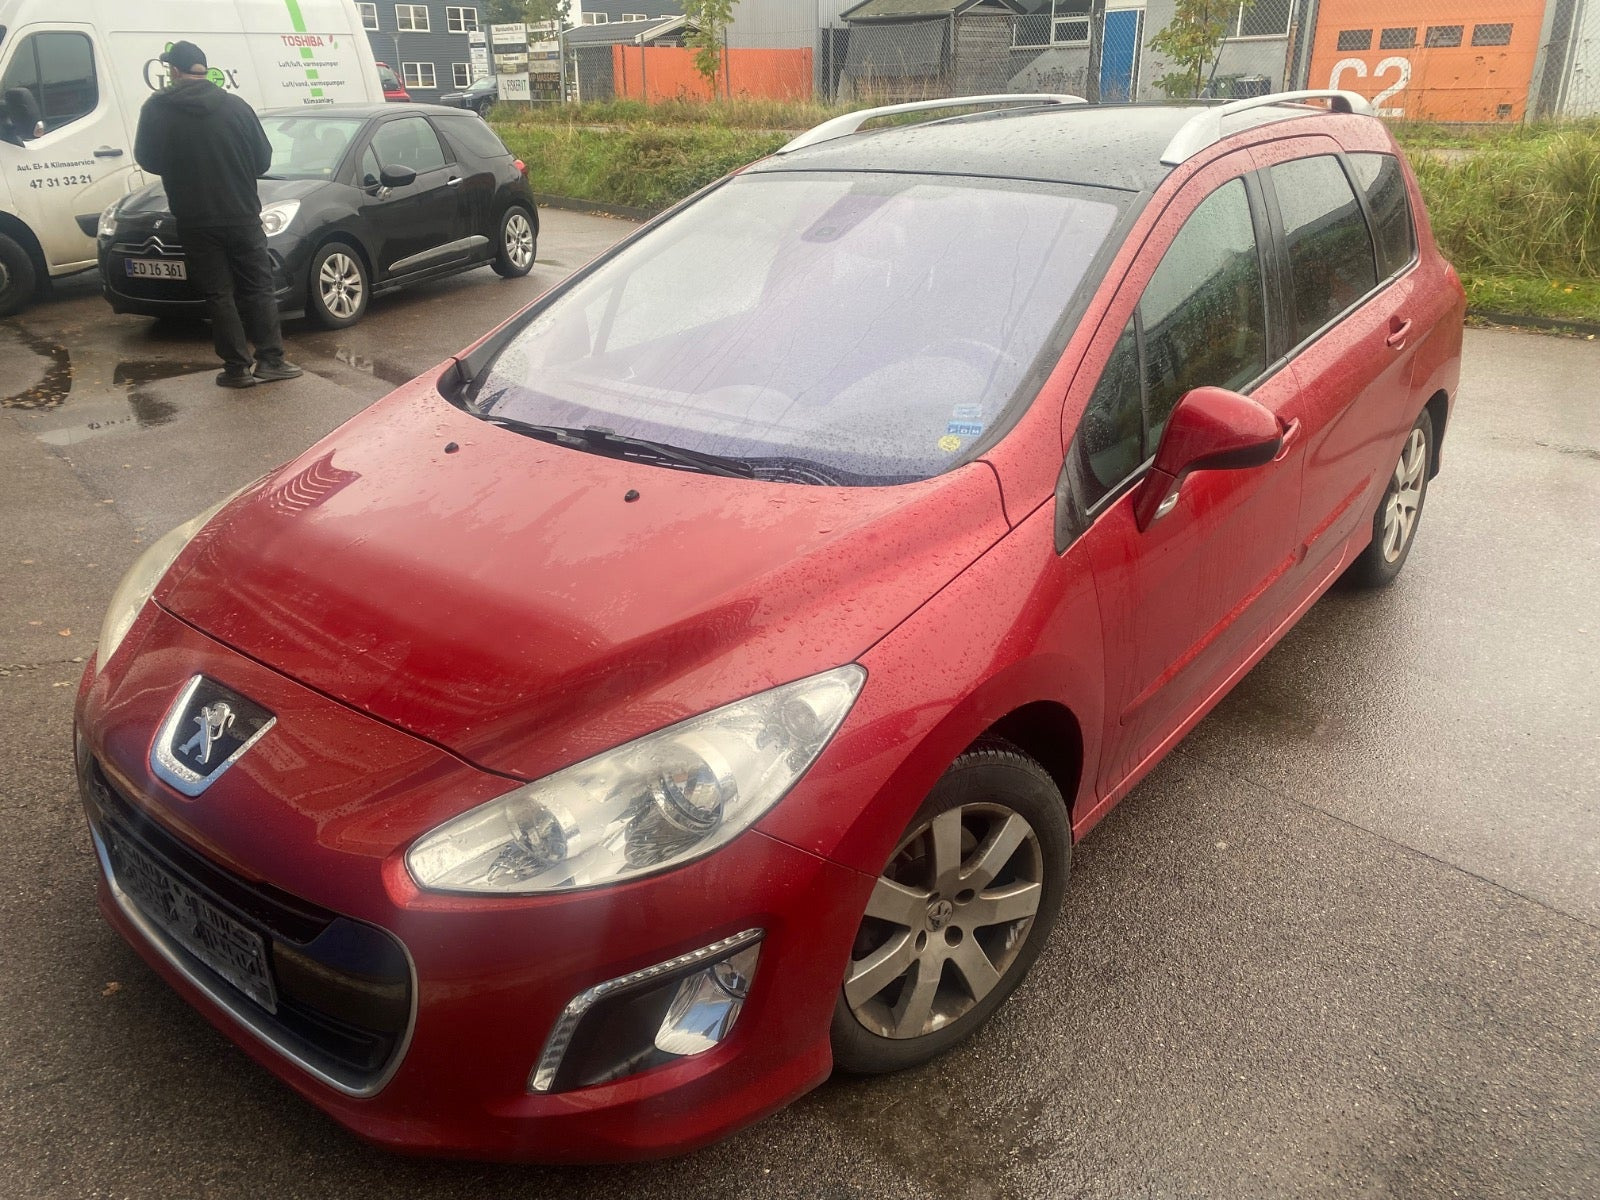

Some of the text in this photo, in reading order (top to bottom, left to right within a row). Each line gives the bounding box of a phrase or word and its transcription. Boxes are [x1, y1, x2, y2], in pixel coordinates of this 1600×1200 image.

[281, 35, 324, 47] TOSHIBA
[51, 160, 95, 168] Klimaservice
[30, 174, 92, 189] 47 31 32 21
[132, 262, 182, 277] ED 16 361
